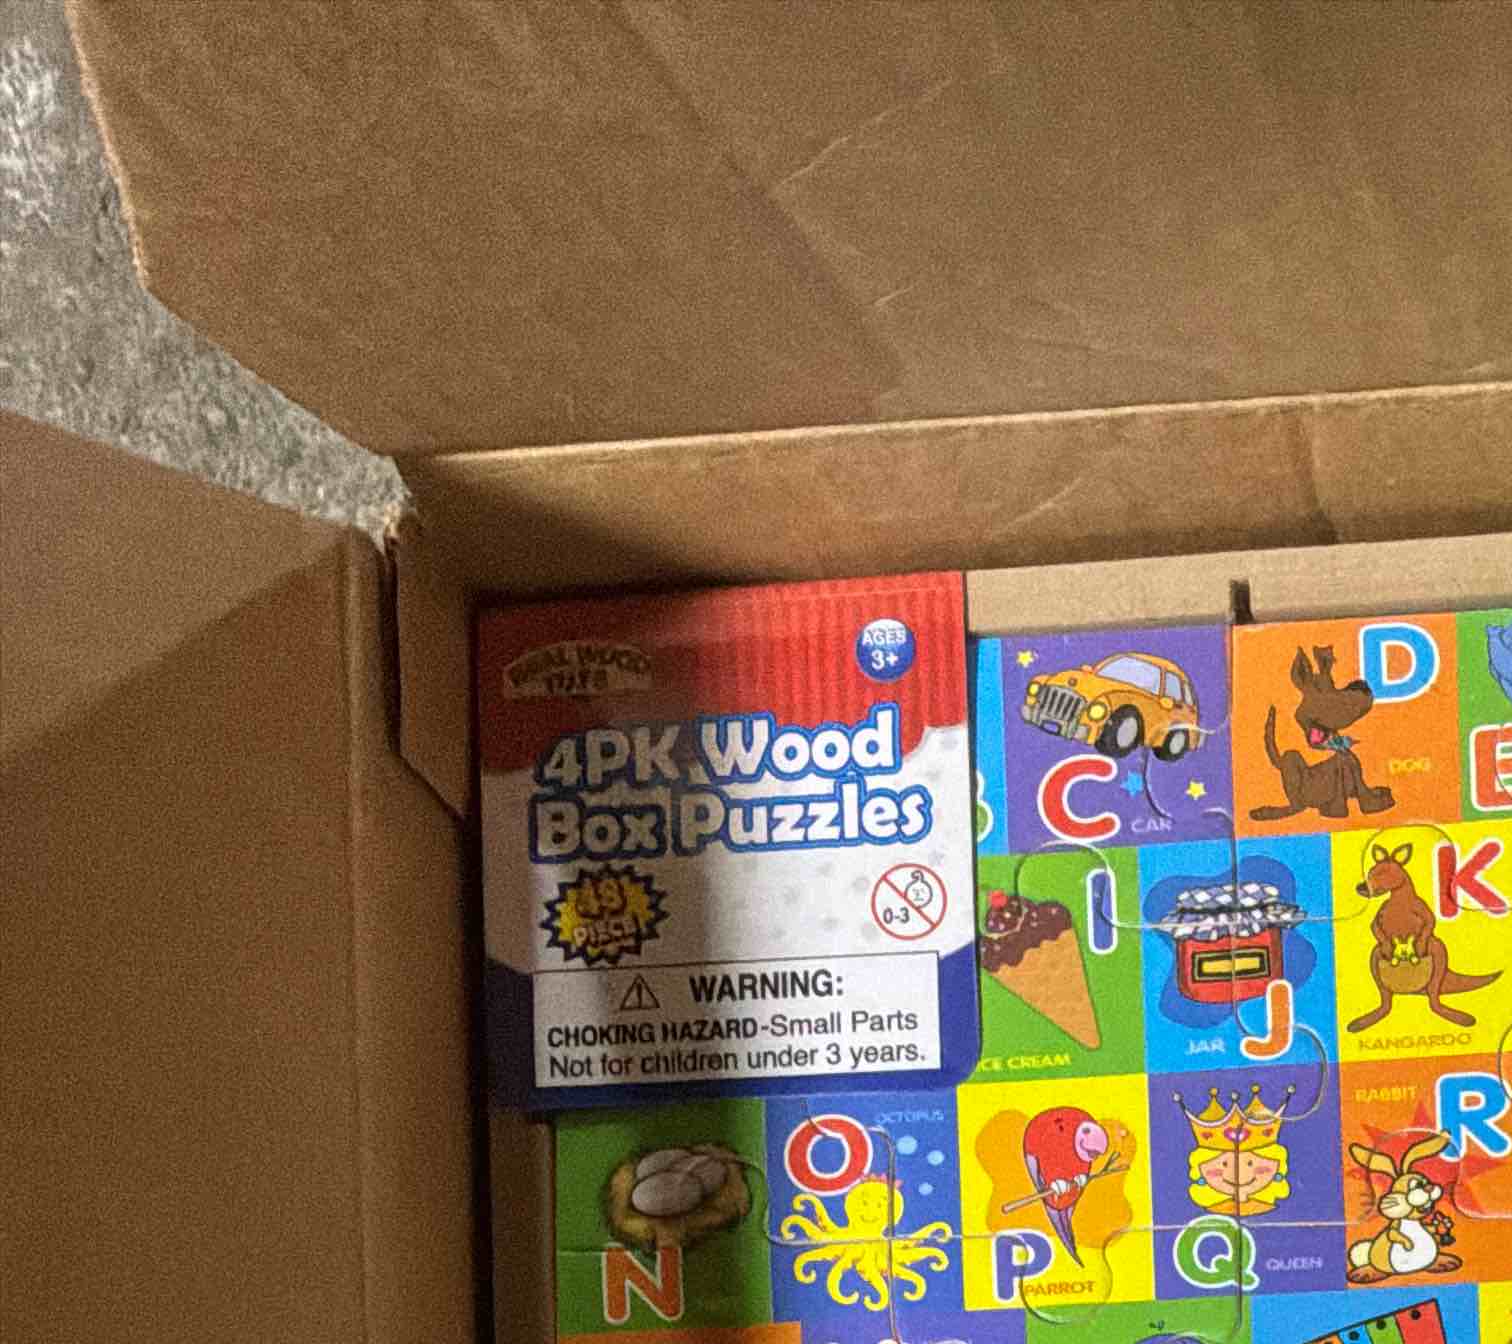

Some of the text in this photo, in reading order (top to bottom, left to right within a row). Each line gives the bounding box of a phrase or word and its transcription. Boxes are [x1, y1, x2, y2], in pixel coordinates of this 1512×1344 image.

[862, 628, 907, 646] AGES
[871, 649, 899, 671] 3+
[1359, 622, 1440, 704] D
[541, 710, 896, 783] 4PK Wood
[1389, 757, 1431, 774] DOG
[1037, 754, 1121, 843] C
[536, 799, 659, 861] Box
[677, 783, 930, 848] Puzzles
[1131, 818, 1173, 834] CAR
[1433, 838, 1508, 918] K
[1087, 868, 1118, 955] I
[690, 969, 844, 1003] WARNING:
[548, 1022, 655, 1047] CHOKING
[851, 1010, 919, 1033] Parts
[1240, 980, 1294, 1059] J
[1183, 1037, 1226, 1056] JAR
[1359, 1032, 1472, 1050] KANGAROO
[550, 1042, 926, 1077] Not for children under 3 years.
[1007, 1052, 1072, 1070] CREAM
[1355, 1086, 1418, 1103] RABBIT
[875, 1110, 945, 1125] OCTOPUS
[1435, 1073, 1512, 1159] R
[784, 1114, 873, 1196] O
[993, 1229, 1053, 1302] P
[1173, 1214, 1260, 1289] Q
[1265, 1256, 1324, 1271] QUEEN
[602, 1242, 685, 1325] N
[1024, 1280, 1096, 1297] PARROT
